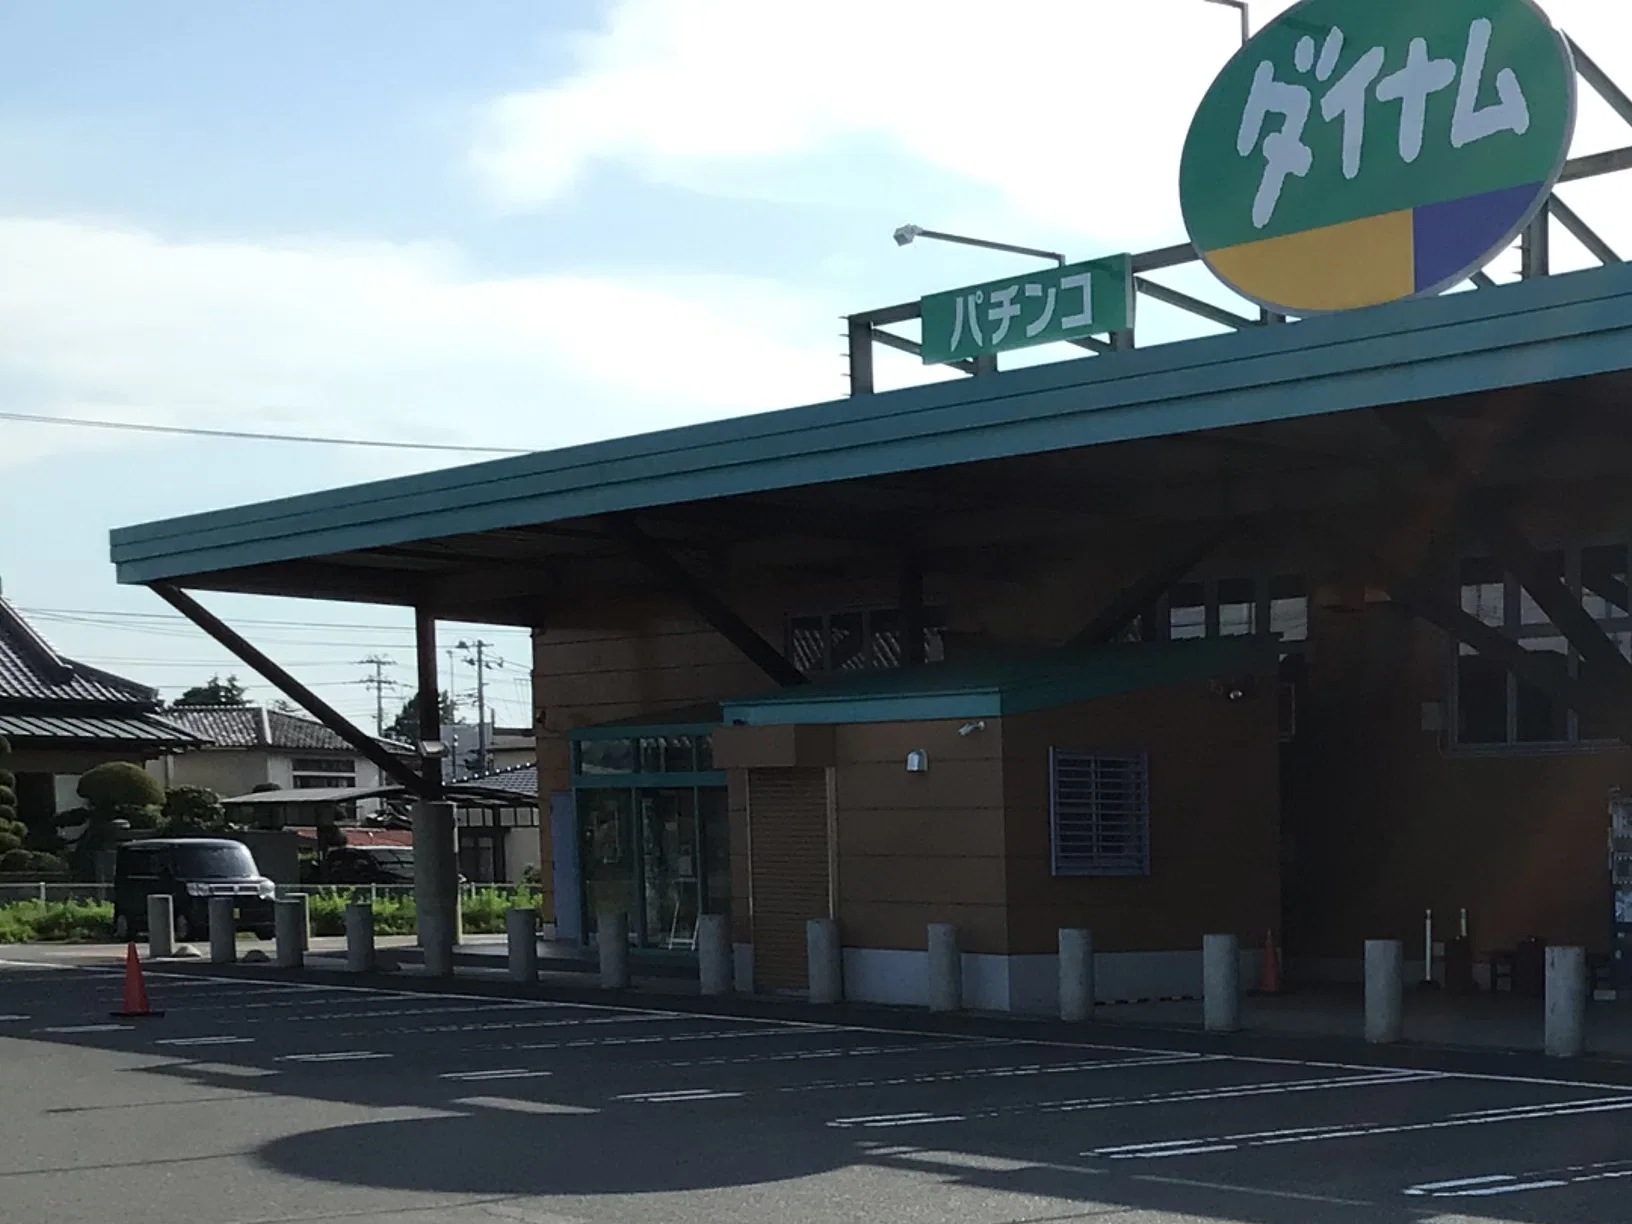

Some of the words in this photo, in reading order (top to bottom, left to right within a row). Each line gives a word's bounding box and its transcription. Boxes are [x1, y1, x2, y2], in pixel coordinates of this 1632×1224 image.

[1236, 17, 1531, 229] ダイナム
[950, 272, 1093, 352] パチンコ
